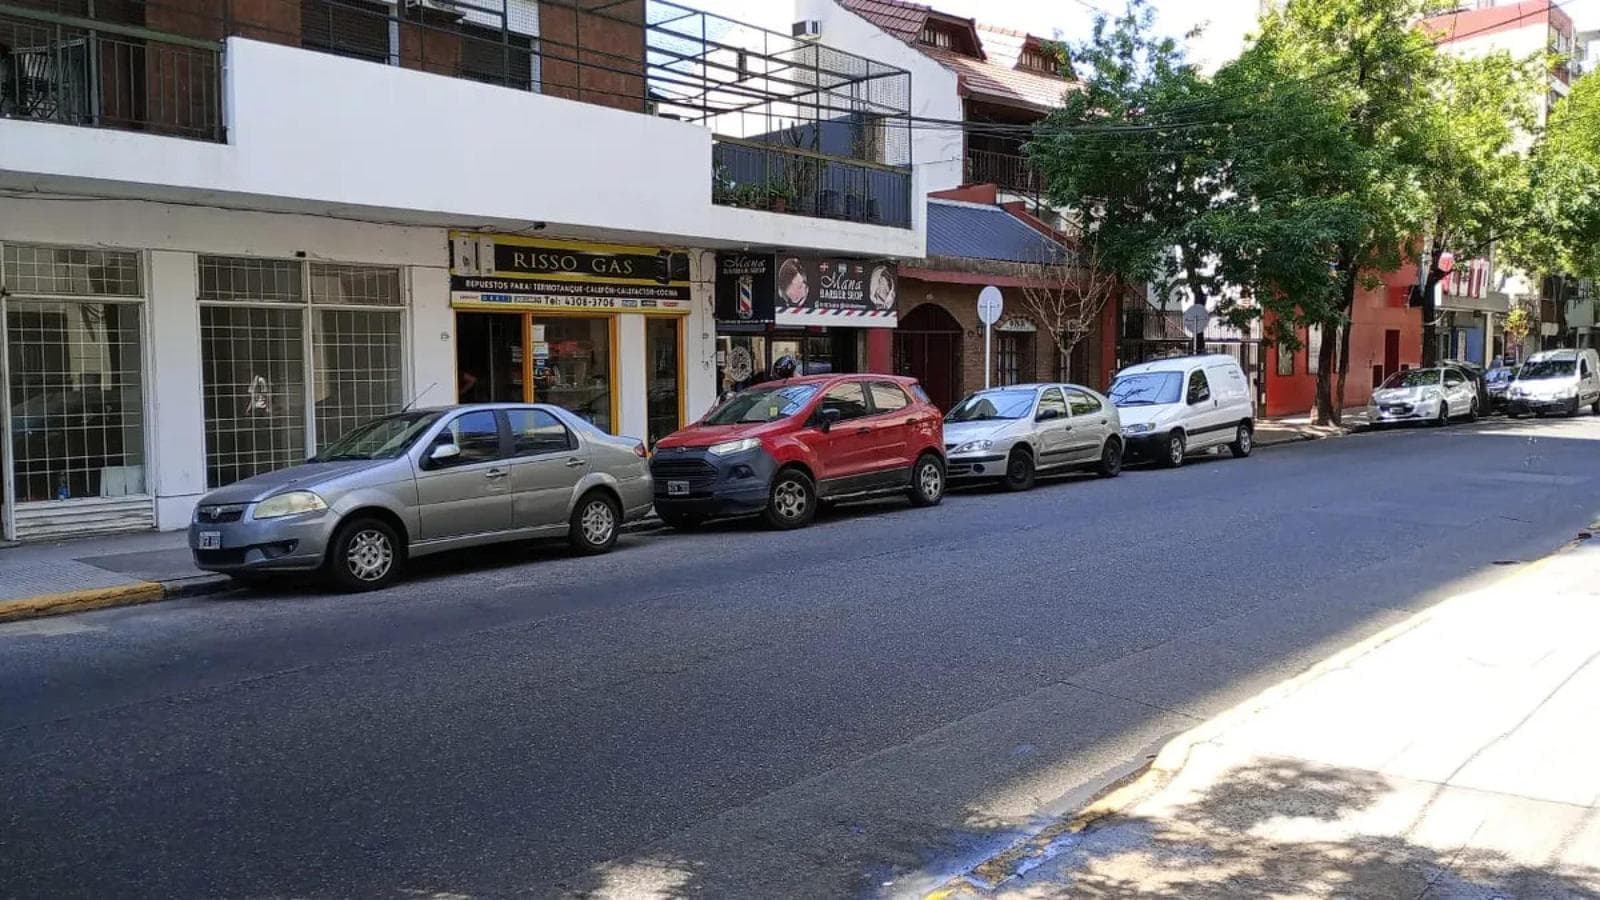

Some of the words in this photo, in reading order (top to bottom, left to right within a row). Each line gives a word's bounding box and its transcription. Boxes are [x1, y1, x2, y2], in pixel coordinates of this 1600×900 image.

[514, 252, 577, 271] RISSO
[591, 258, 633, 274] GAS
[465, 279, 508, 290] REPUESTOS
[820, 289, 846, 300] BARBER
[847, 290, 864, 301] SHOP
[565, 297, 615, 308] 4308-3706
